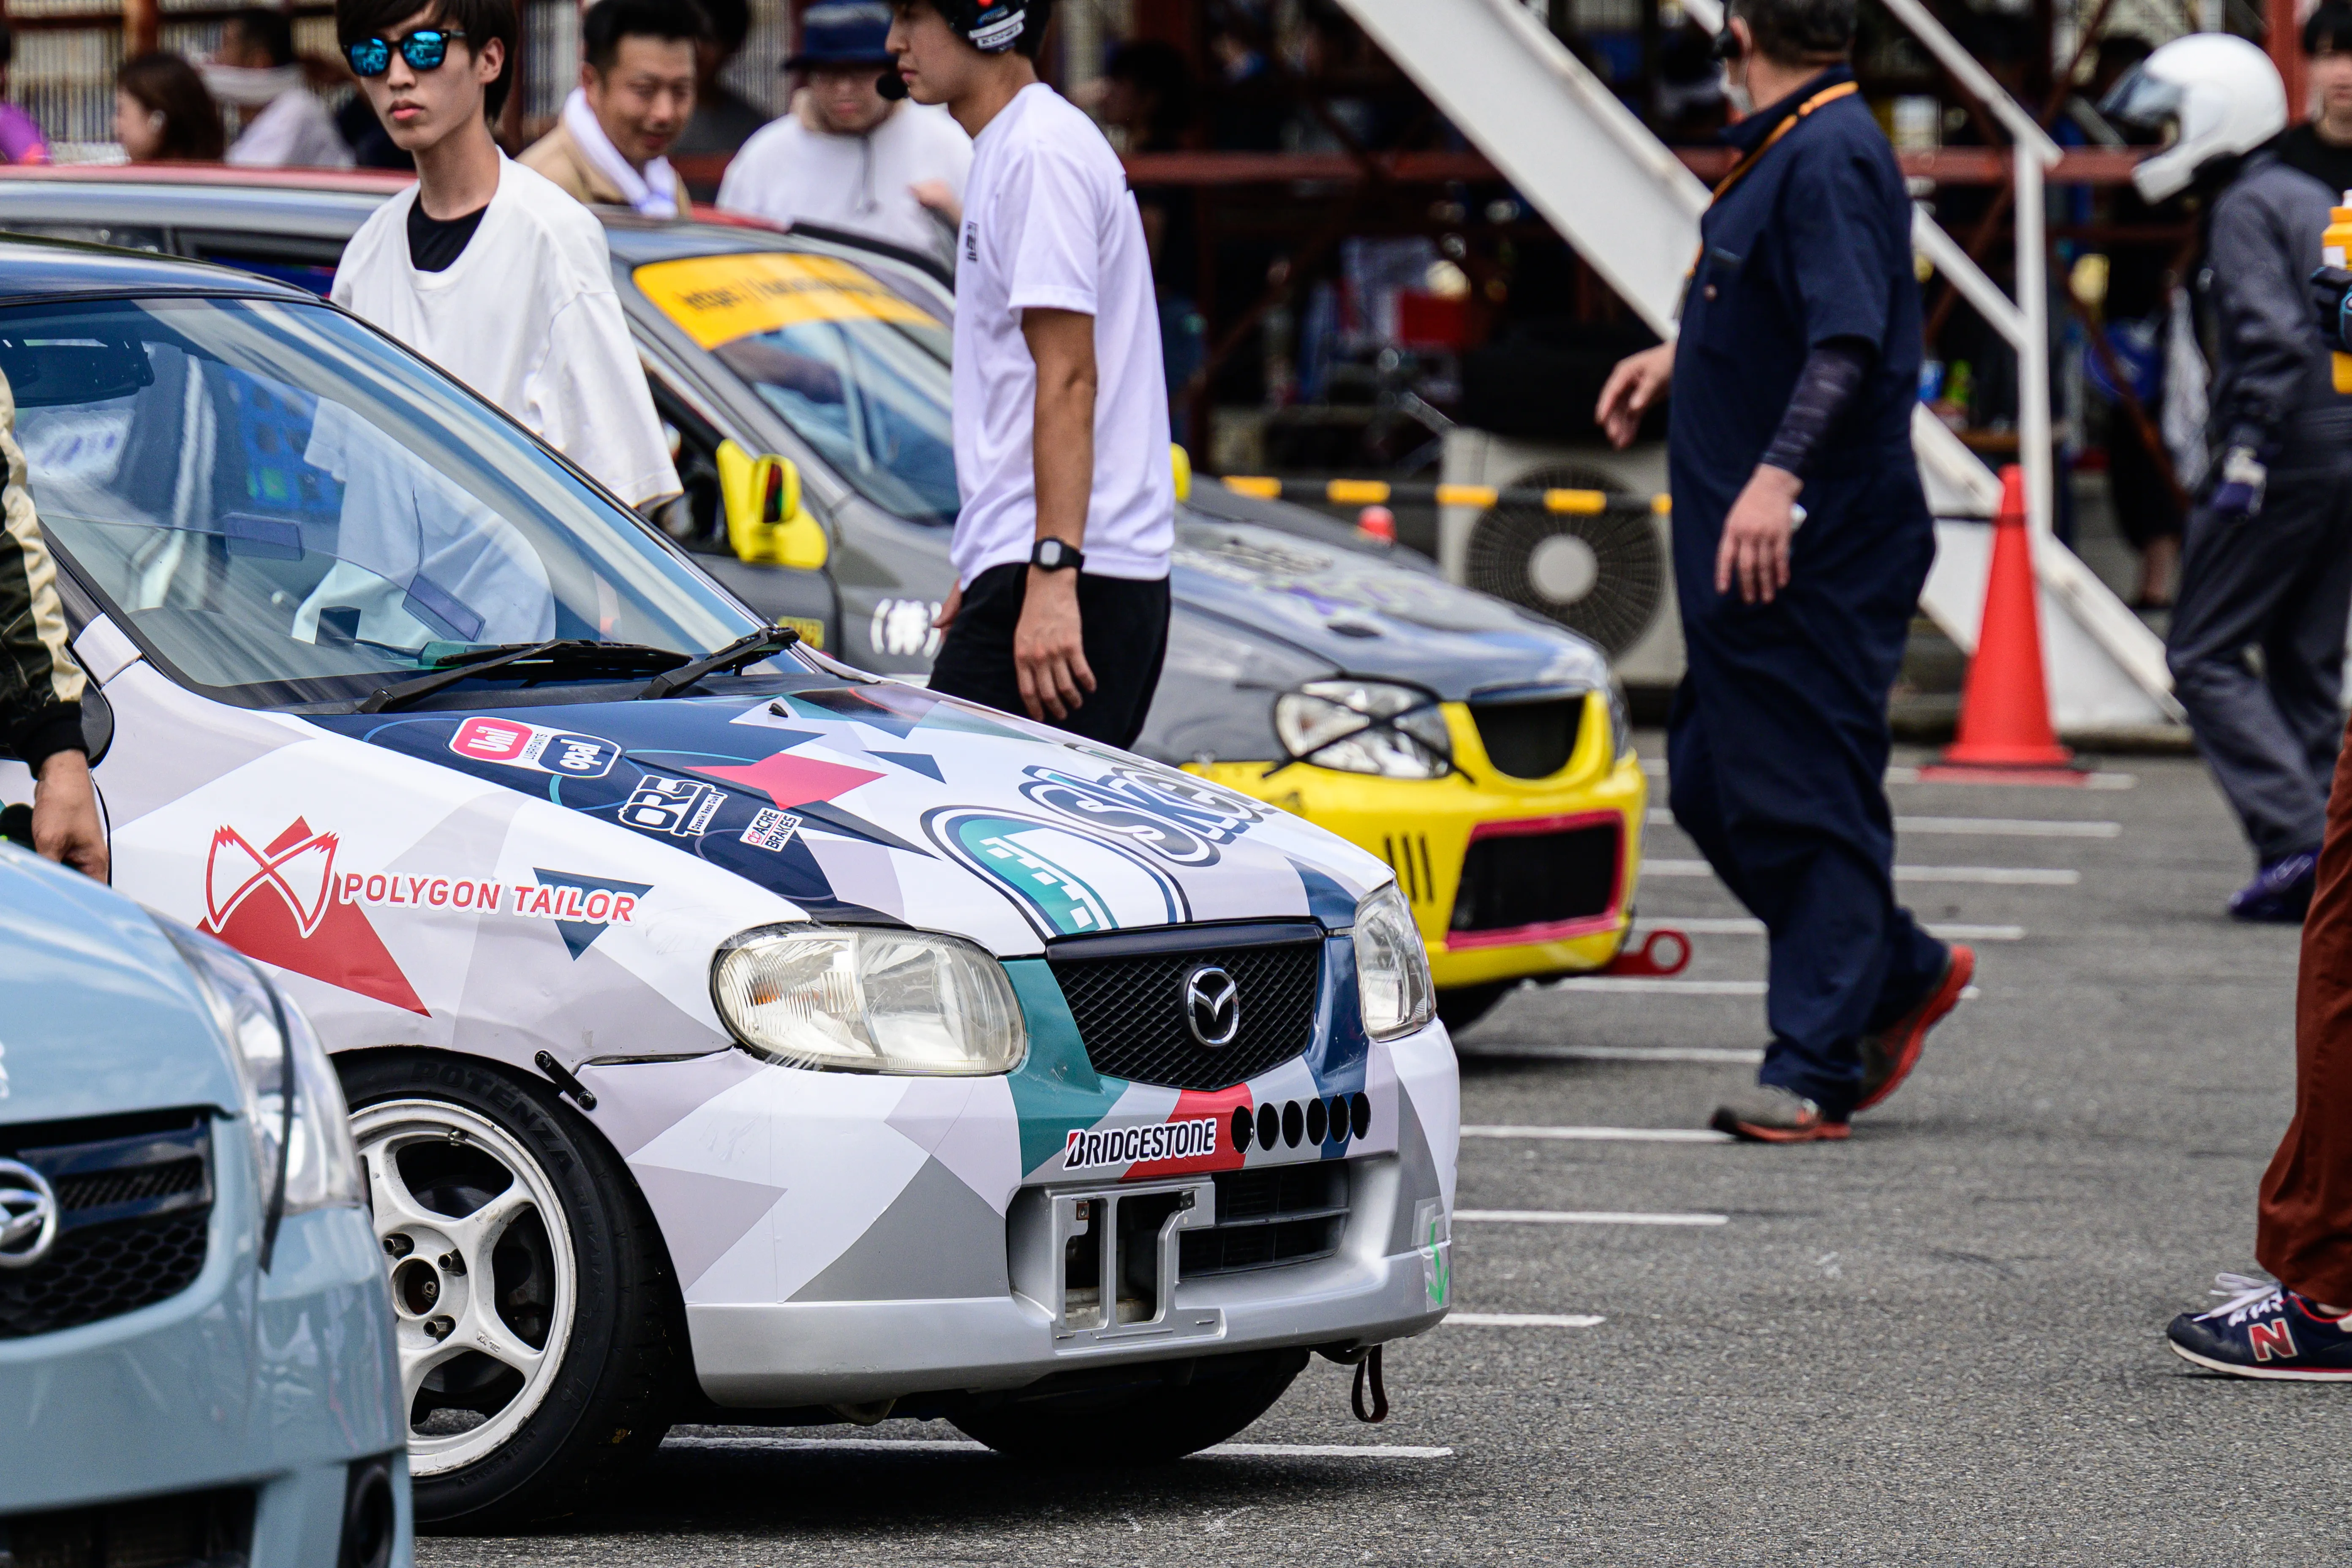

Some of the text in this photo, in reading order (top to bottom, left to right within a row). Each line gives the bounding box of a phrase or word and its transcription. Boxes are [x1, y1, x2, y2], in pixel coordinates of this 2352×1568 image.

[467, 725, 519, 752] Unil
[523, 733, 548, 760] LUBRIFIANTS
[560, 738, 602, 770] opal
[701, 804, 714, 814] Race
[752, 809, 780, 836] ACRE
[765, 814, 797, 849] BRAKES
[343, 873, 637, 922] POLYGON TAILOR
[410, 1061, 574, 1177] POTENZA
[1064, 1121, 1215, 1168] BRIDGESTONE
[2248, 1317, 2299, 1362] N
